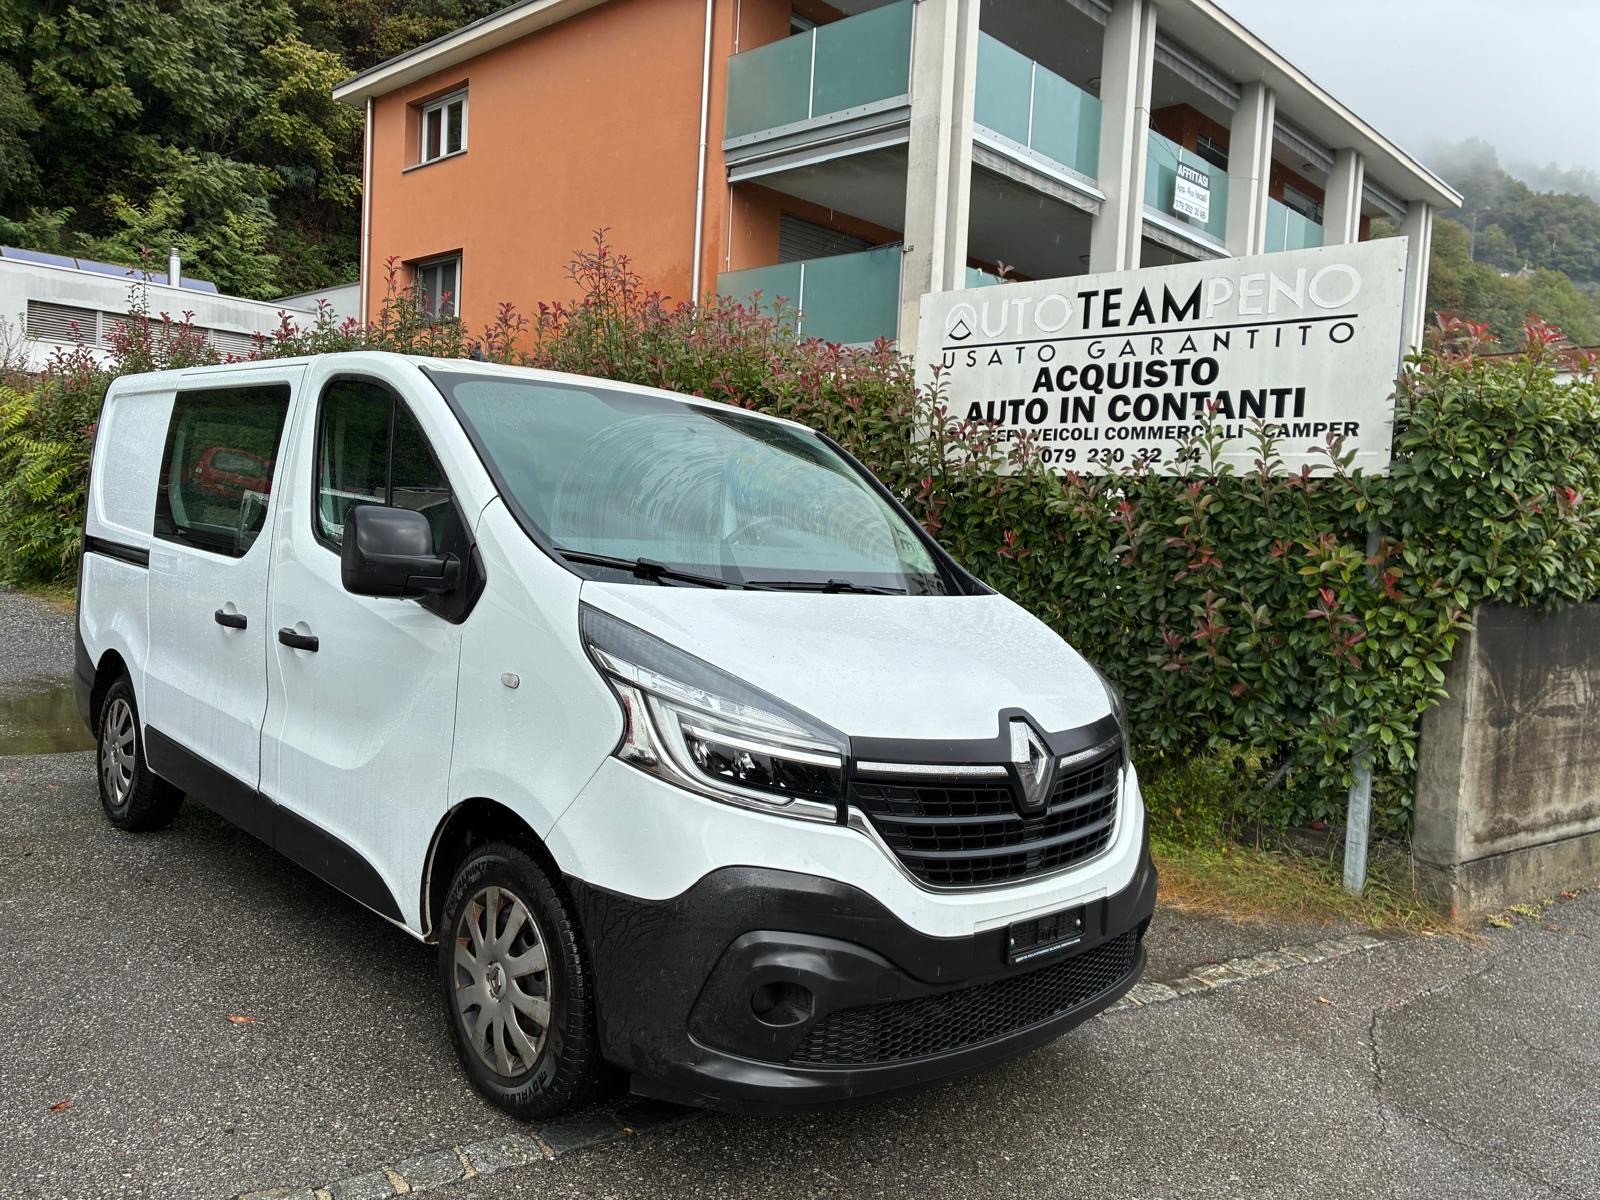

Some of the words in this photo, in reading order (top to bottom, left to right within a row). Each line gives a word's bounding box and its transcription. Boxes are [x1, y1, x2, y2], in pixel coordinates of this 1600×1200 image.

[943, 345, 1056, 369] USATO
[1087, 322, 1355, 359] GARANTITO
[1032, 356, 1220, 394] ACQUISTO
[966, 398, 1049, 425] AUTO
[1060, 396, 1096, 423] IN
[1108, 387, 1306, 423] CONTANTI
[1031, 427, 1099, 442] VEICOLI
[1104, 424, 1244, 441] COMMERCLI
[1264, 421, 1360, 438] CAMPER
[1041, 448, 1077, 464] 079
[1087, 447, 1125, 463] 230
[1137, 447, 1162, 463] 32
